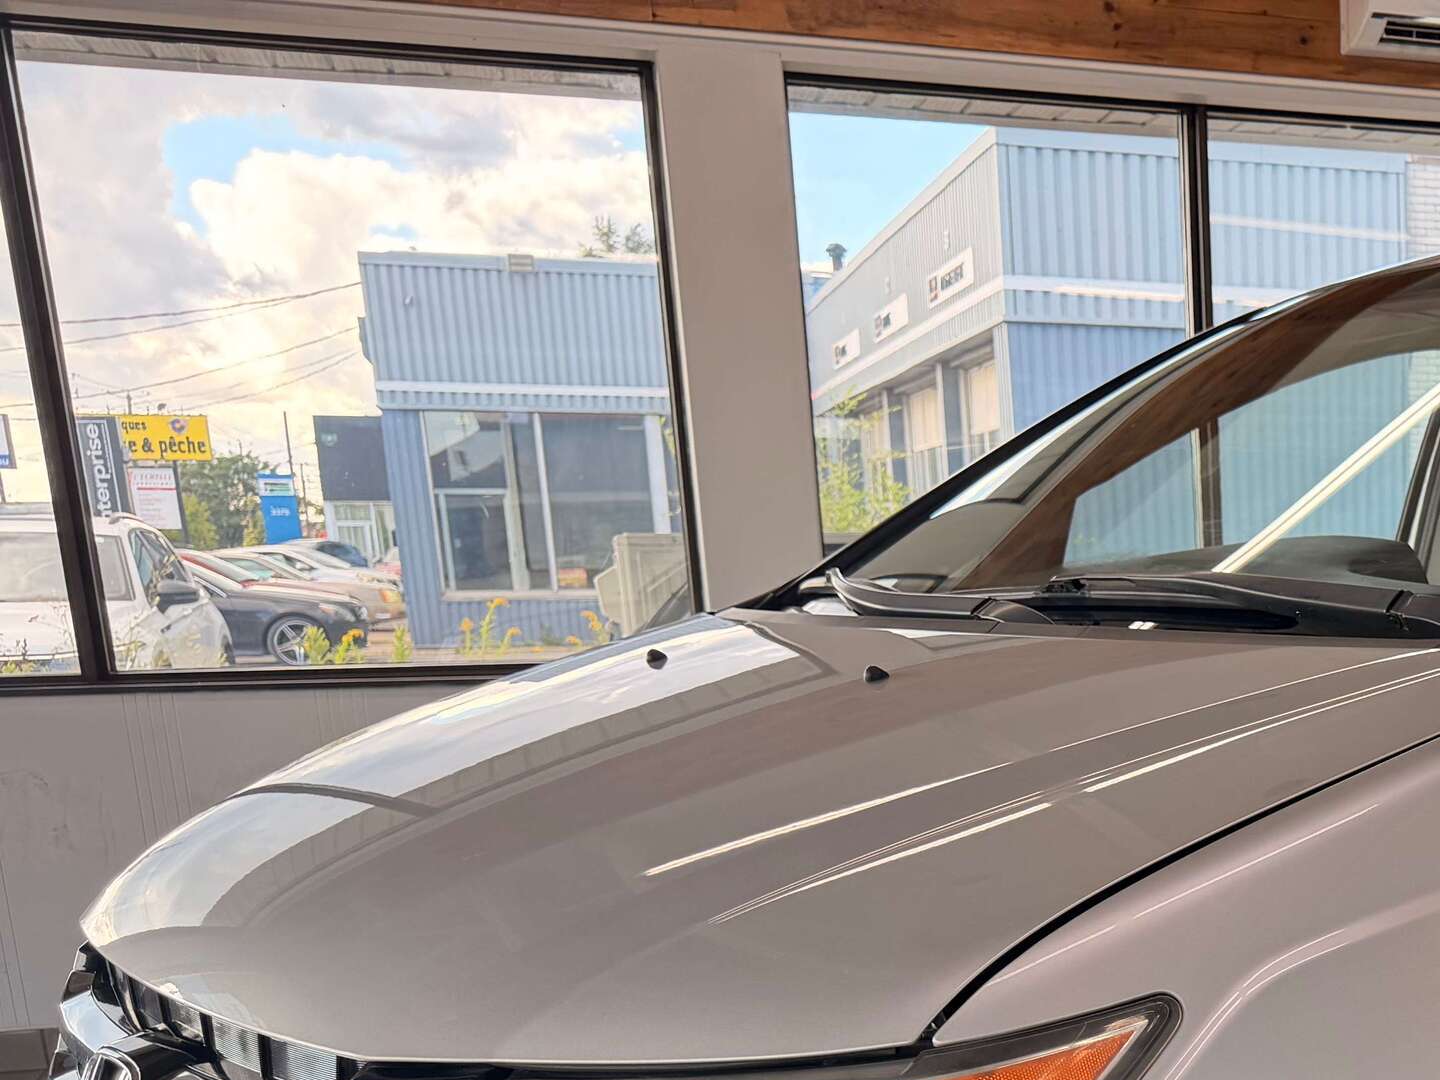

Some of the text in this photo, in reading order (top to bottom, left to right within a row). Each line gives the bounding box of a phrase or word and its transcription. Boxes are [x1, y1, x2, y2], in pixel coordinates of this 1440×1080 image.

[87, 423, 112, 517] nterprise
[142, 437, 154, 453] &
[159, 436, 207, 459] pêche
